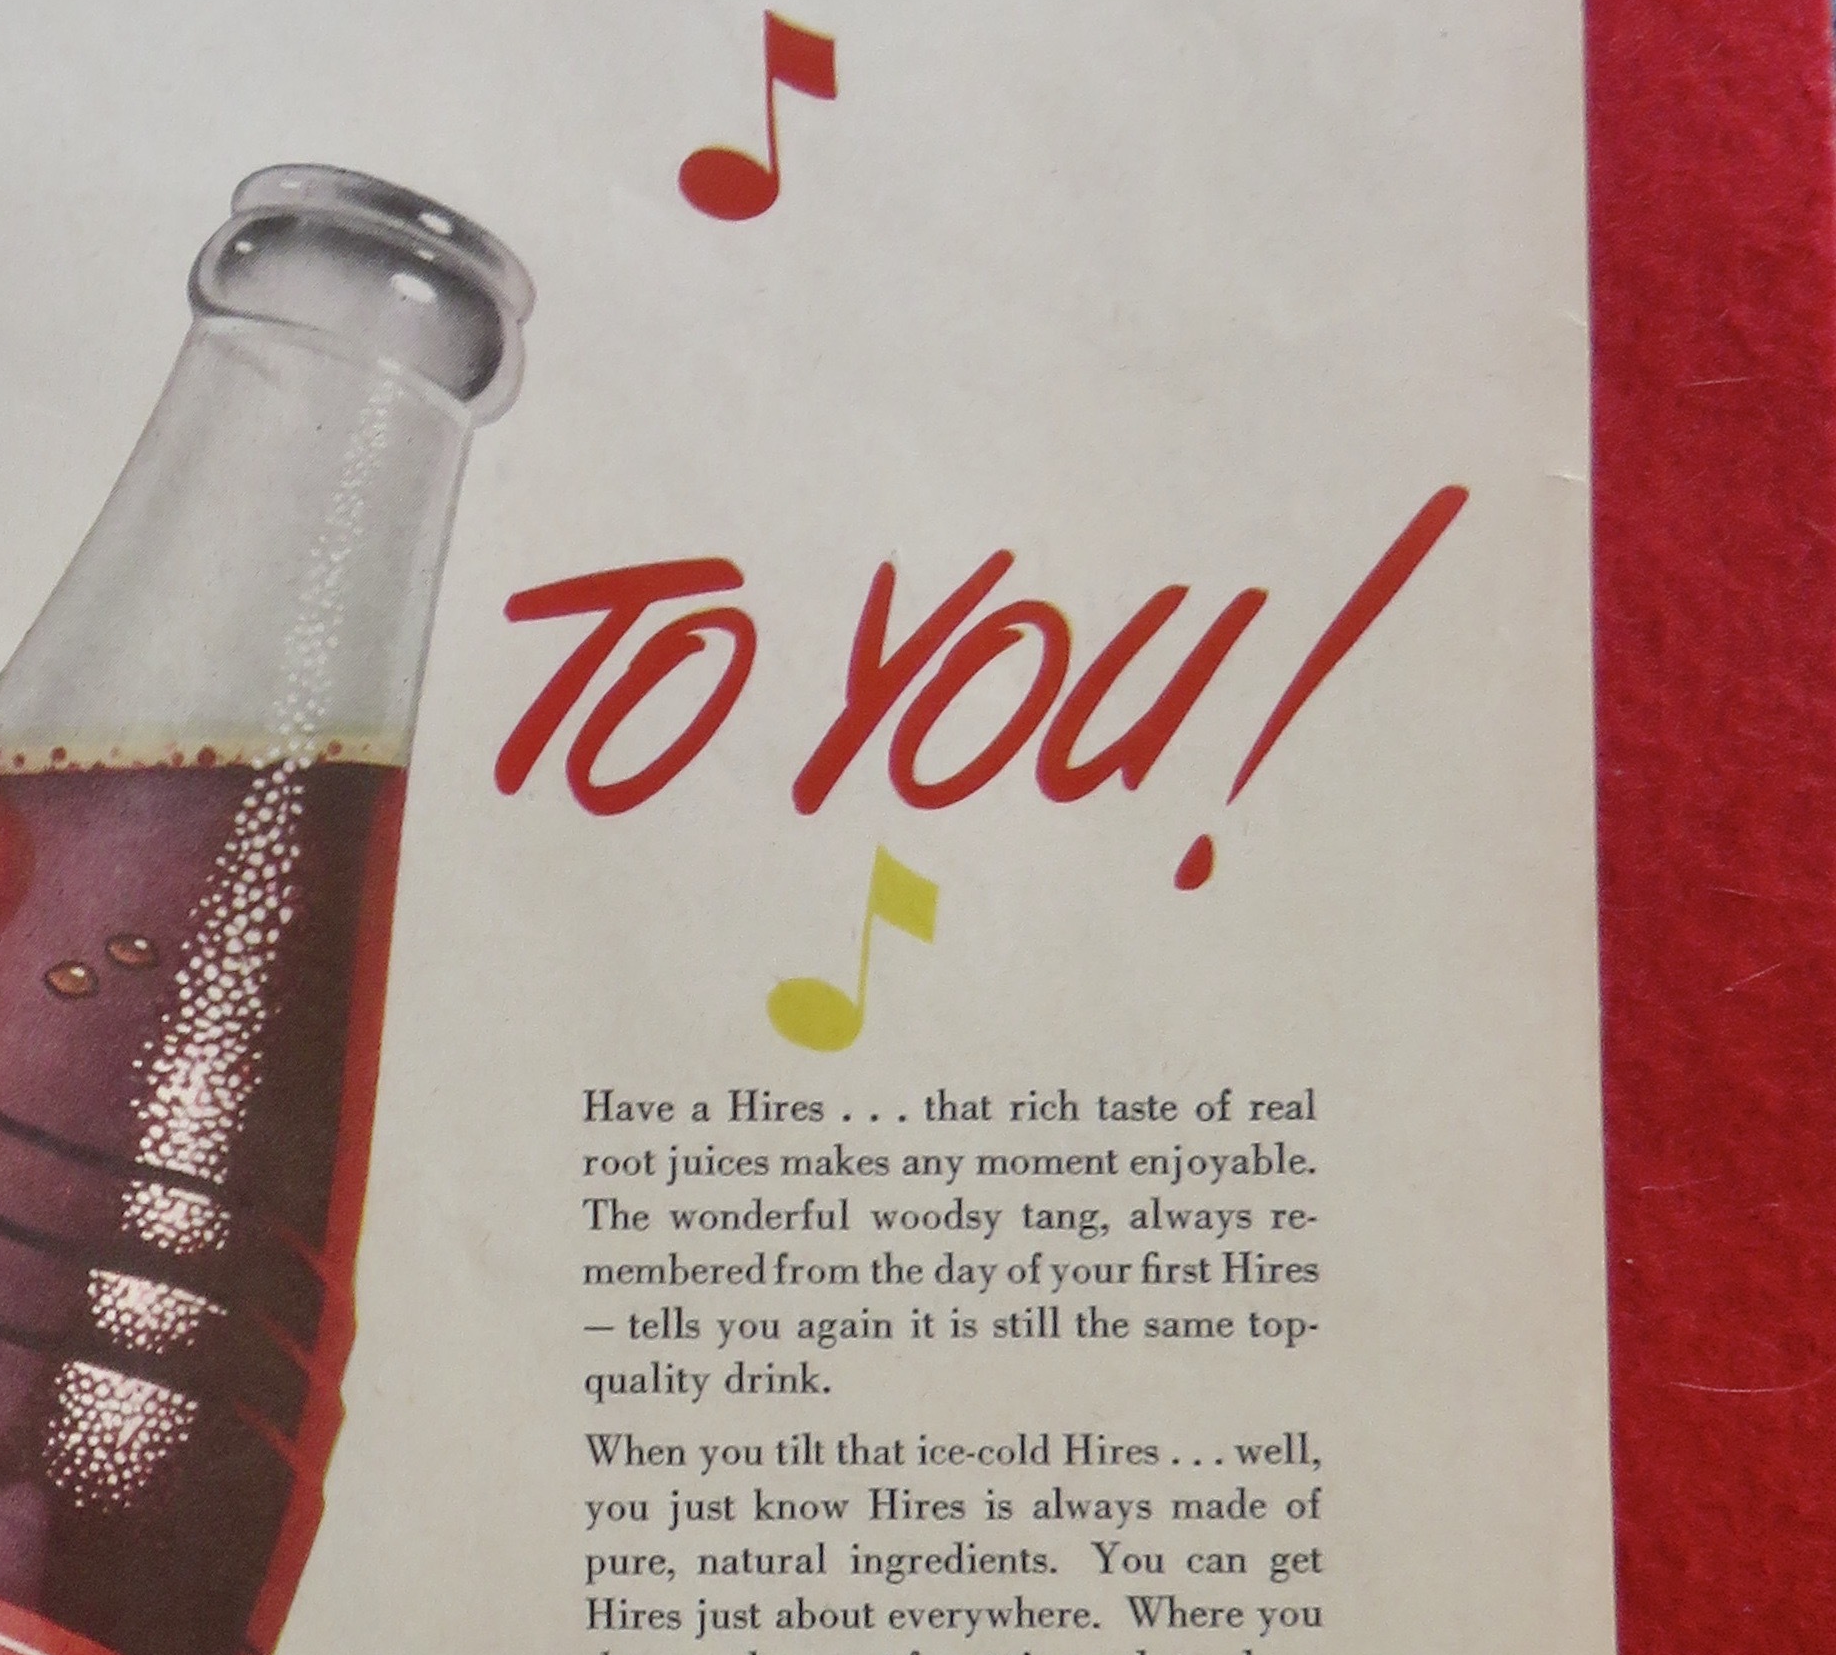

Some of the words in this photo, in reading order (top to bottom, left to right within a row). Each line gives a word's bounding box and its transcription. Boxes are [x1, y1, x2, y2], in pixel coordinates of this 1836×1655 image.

[494, 557, 758, 817] TO
[791, 485, 1470, 892] YOU!
[581, 1087, 676, 1124] Have
[690, 1100, 713, 1124] a
[726, 1087, 826, 1124] Hires
[923, 1086, 994, 1123] that
[1008, 1087, 1082, 1123] rich
[1096, 1093, 1180, 1123] taste
[1193, 1086, 1234, 1124] of
[1247, 1086, 1318, 1123] real
[582, 1148, 657, 1178] root
[664, 1142, 771, 1188] juices
[778, 1141, 892, 1178] makes
[900, 1154, 966, 1187] any
[974, 1148, 1120, 1177] moment
[1128, 1140, 1318, 1187] enjoyable.
[580, 1196, 651, 1233] The
[667, 1195, 852, 1232] wonderful
[868, 1195, 1004, 1242] woodsy
[1020, 1201, 1112, 1242] tang,
[1128, 1195, 1254, 1241] always
[1269, 1208, 1319, 1231] re-
[582, 1250, 768, 1287] membered
[772, 1250, 862, 1287] from
[869, 1250, 925, 1287] the
[932, 1250, 999, 1296] day
[1005, 1250, 1045, 1286] of
[1048, 1262, 1134, 1295] your
[1140, 1249, 1214, 1286] first
[1220, 1249, 1322, 1285] Hires
[626, 1304, 702, 1342] tells
[715, 1317, 781, 1351] you
[796, 1306, 895, 1351] again
[910, 1306, 936, 1340] it
[949, 1305, 980, 1340] is
[991, 1304, 1062, 1340] still
[1074, 1303, 1131, 1340] the
[1143, 1316, 1236, 1340] same
[1247, 1310, 1320, 1350] top-
[583, 1359, 712, 1406] quality
[722, 1359, 832, 1396] drink.
[583, 1431, 688, 1468] When
[697, 1444, 765, 1478] you
[774, 1430, 827, 1468] tilt
[835, 1431, 907, 1467] that
[915, 1431, 1052, 1468] ice-cold
[1061, 1431, 1161, 1467] Hires
[1232, 1429, 1323, 1473] well,
[583, 1499, 651, 1532] you
[666, 1488, 737, 1533] just
[752, 1486, 851, 1523] know
[867, 1486, 967, 1522] Hires
[983, 1487, 1015, 1522] is
[1031, 1485, 1154, 1531] always
[1170, 1485, 1269, 1522] made
[1284, 1485, 1324, 1521] of
[584, 1553, 677, 1587] pure,
[696, 1540, 828, 1577] natural
[849, 1539, 1059, 1586] ingredients.
[1088, 1539, 1166, 1576] You
[1185, 1552, 1249, 1575] can
[1268, 1546, 1325, 1585] get
[584, 1595, 684, 1632] Hires
[693, 1596, 763, 1642] just
[774, 1595, 877, 1631] about
[887, 1593, 1102, 1640] everywhere.
[1124, 1593, 1245, 1630] Where
[1255, 1605, 1324, 1639] you
